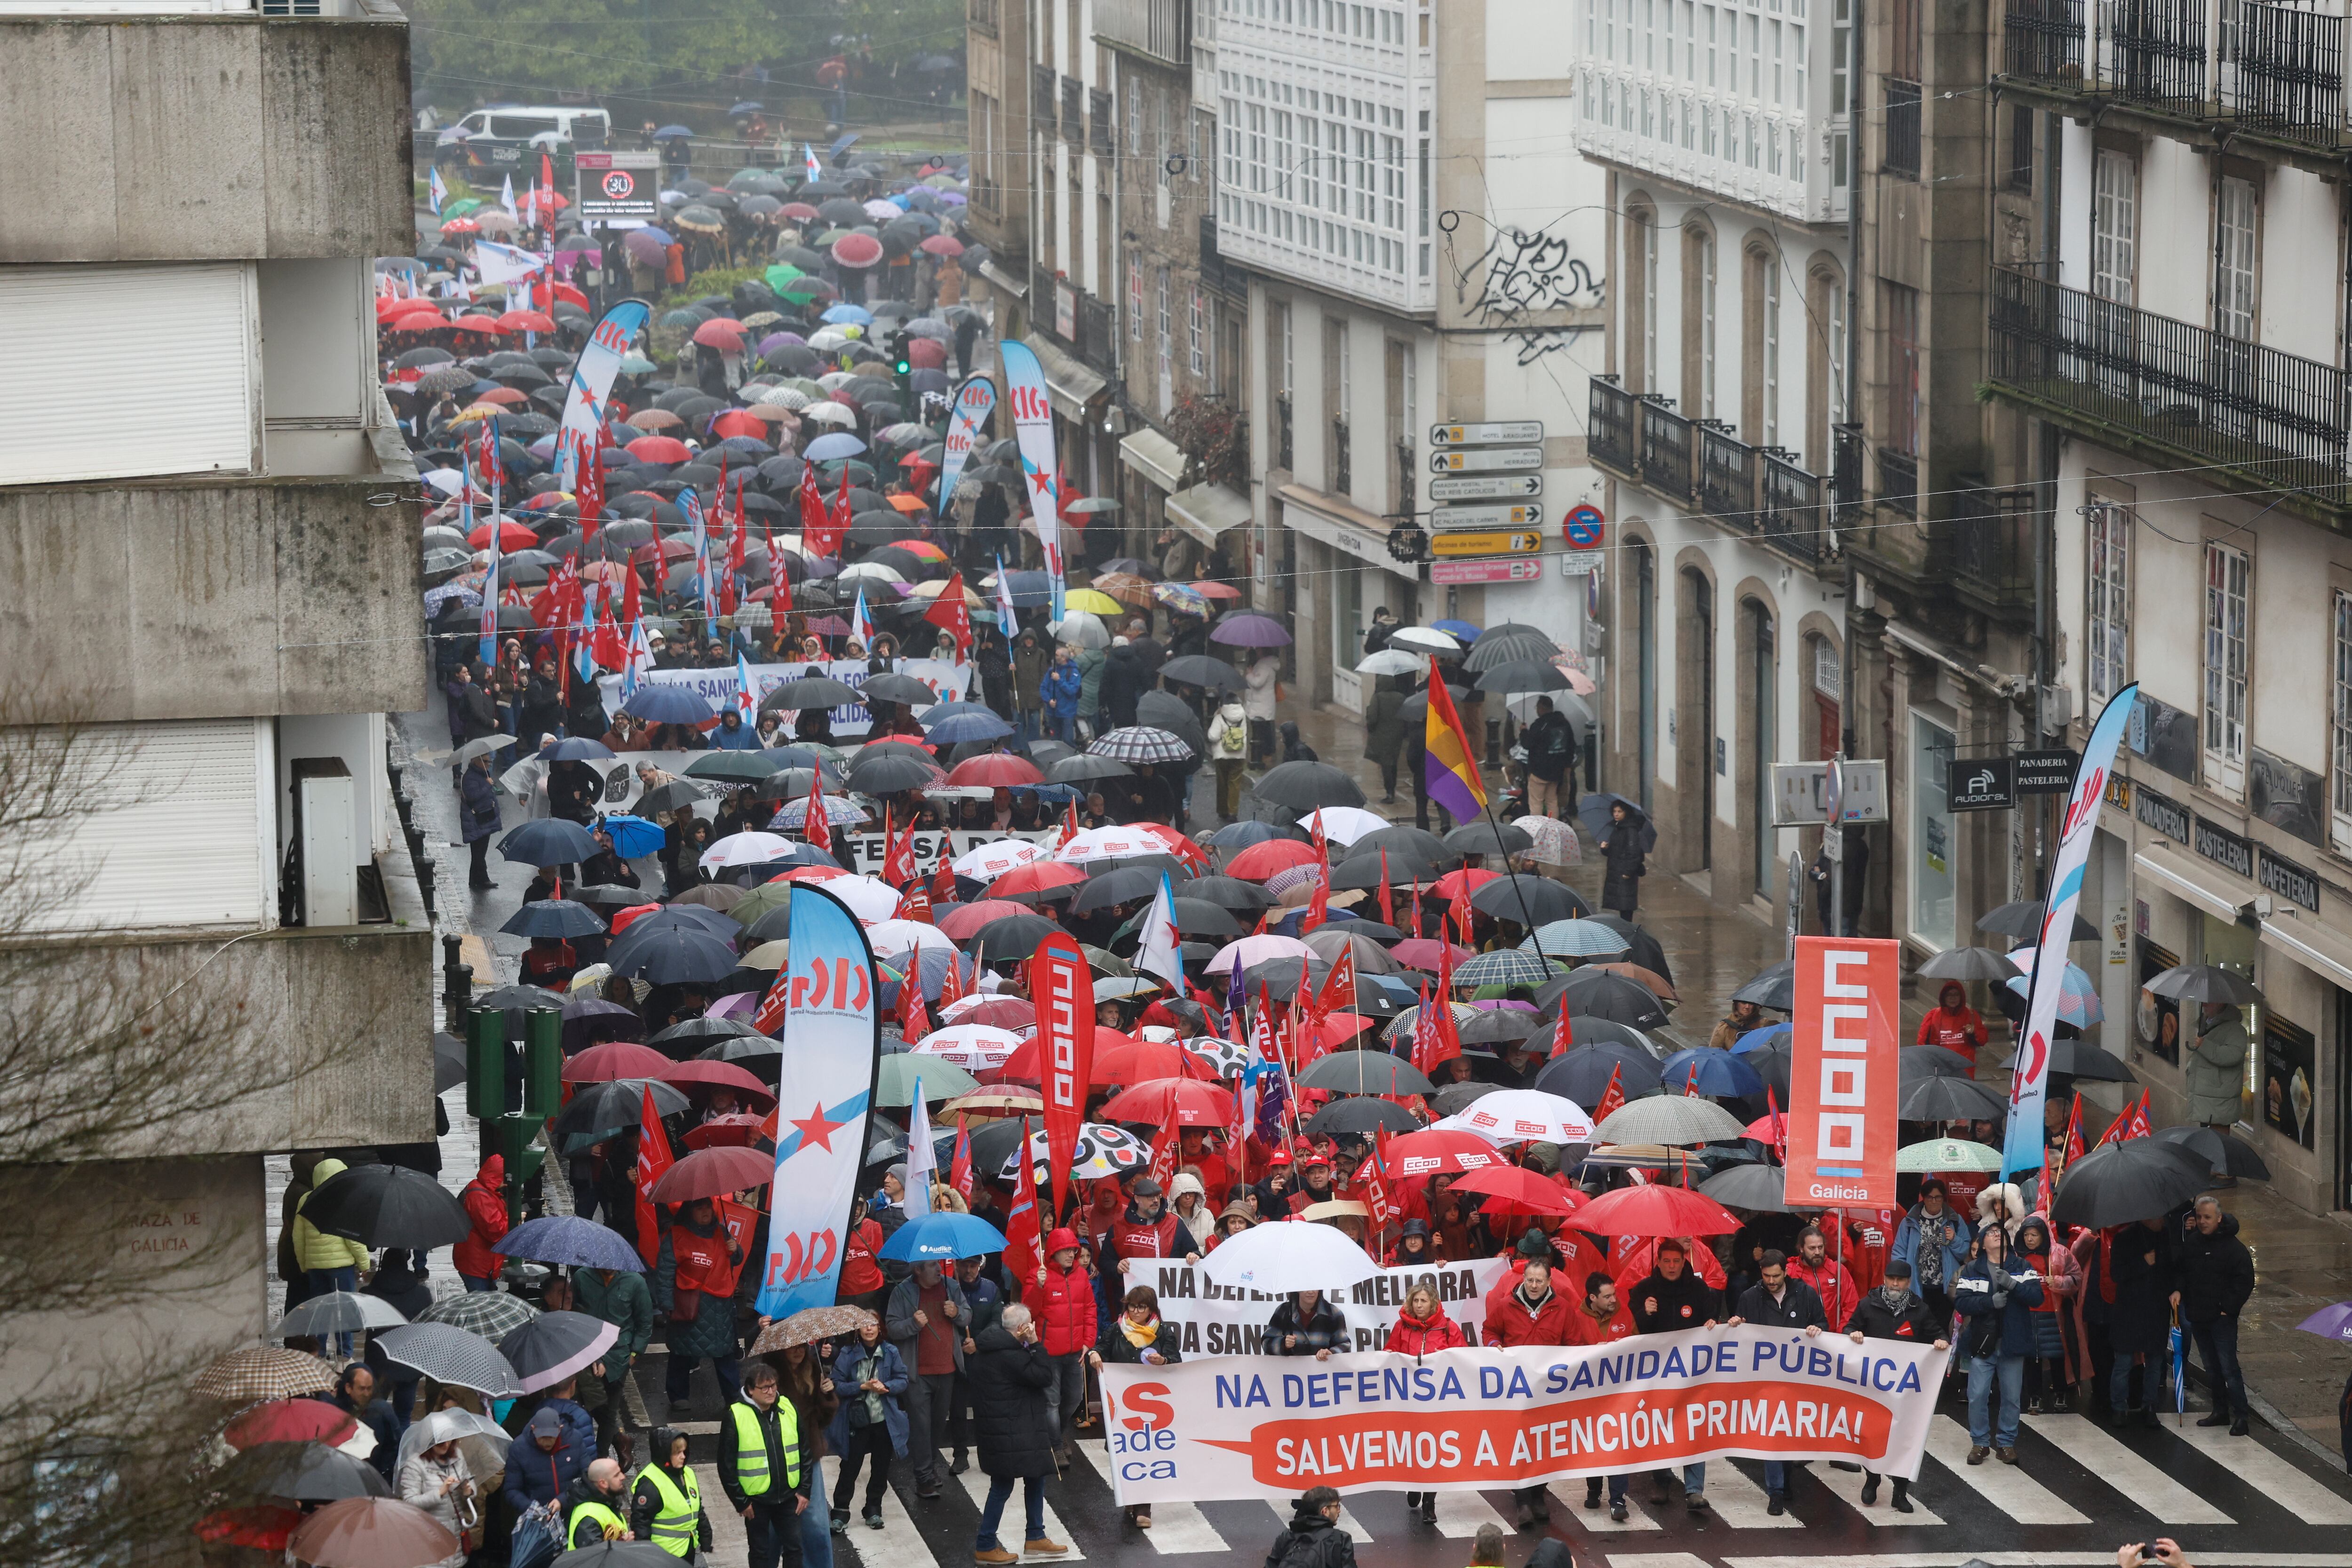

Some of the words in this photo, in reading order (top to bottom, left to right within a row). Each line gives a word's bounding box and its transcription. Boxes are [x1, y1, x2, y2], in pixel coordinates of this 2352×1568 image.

[609, 177, 628, 192] 30
[596, 320, 628, 354] CIG
[964, 386, 991, 406] CIG
[1011, 386, 1049, 419] CIG
[947, 434, 970, 451] CIG
[2019, 758, 2067, 767] PANADERIA
[2018, 776, 2069, 785] PASTELERIA
[2136, 793, 2186, 844] PANADERÍA
[2196, 826, 2249, 877] PASTELERÍA
[987, 860, 1008, 869] CCOO
[2259, 857, 2317, 911] CAFETERÍA
[1817, 949, 1868, 1162] CCOO
[1475, 1115, 1496, 1125] CCOO
[1406, 1159, 1438, 1169] CCOO
[1461, 1155, 1489, 1164] CCOO
[1809, 1183, 1868, 1201] Galicia
[183, 1211, 200, 1225] DE
[131, 1238, 189, 1253] GALICIA
[1127, 1234, 1155, 1246] COO
[1159, 1267, 1196, 1298] NA
[1240, 1273, 1253, 1281] bng
[1216, 1374, 1271, 1409] NA
[1283, 1366, 1466, 1408] DEFENSA
[1479, 1365, 1534, 1399] DA
[1545, 1340, 1739, 1395] SANIDADE
[1753, 1336, 1922, 1393] PÚBLICA
[1275, 1429, 1462, 1476] SALVEMOS
[1473, 1429, 1500, 1467] A
[1510, 1398, 1675, 1467] ATENCIÓN
[1687, 1398, 1863, 1445] PRIMARIA!
[1121, 1460, 1177, 1481] ca
